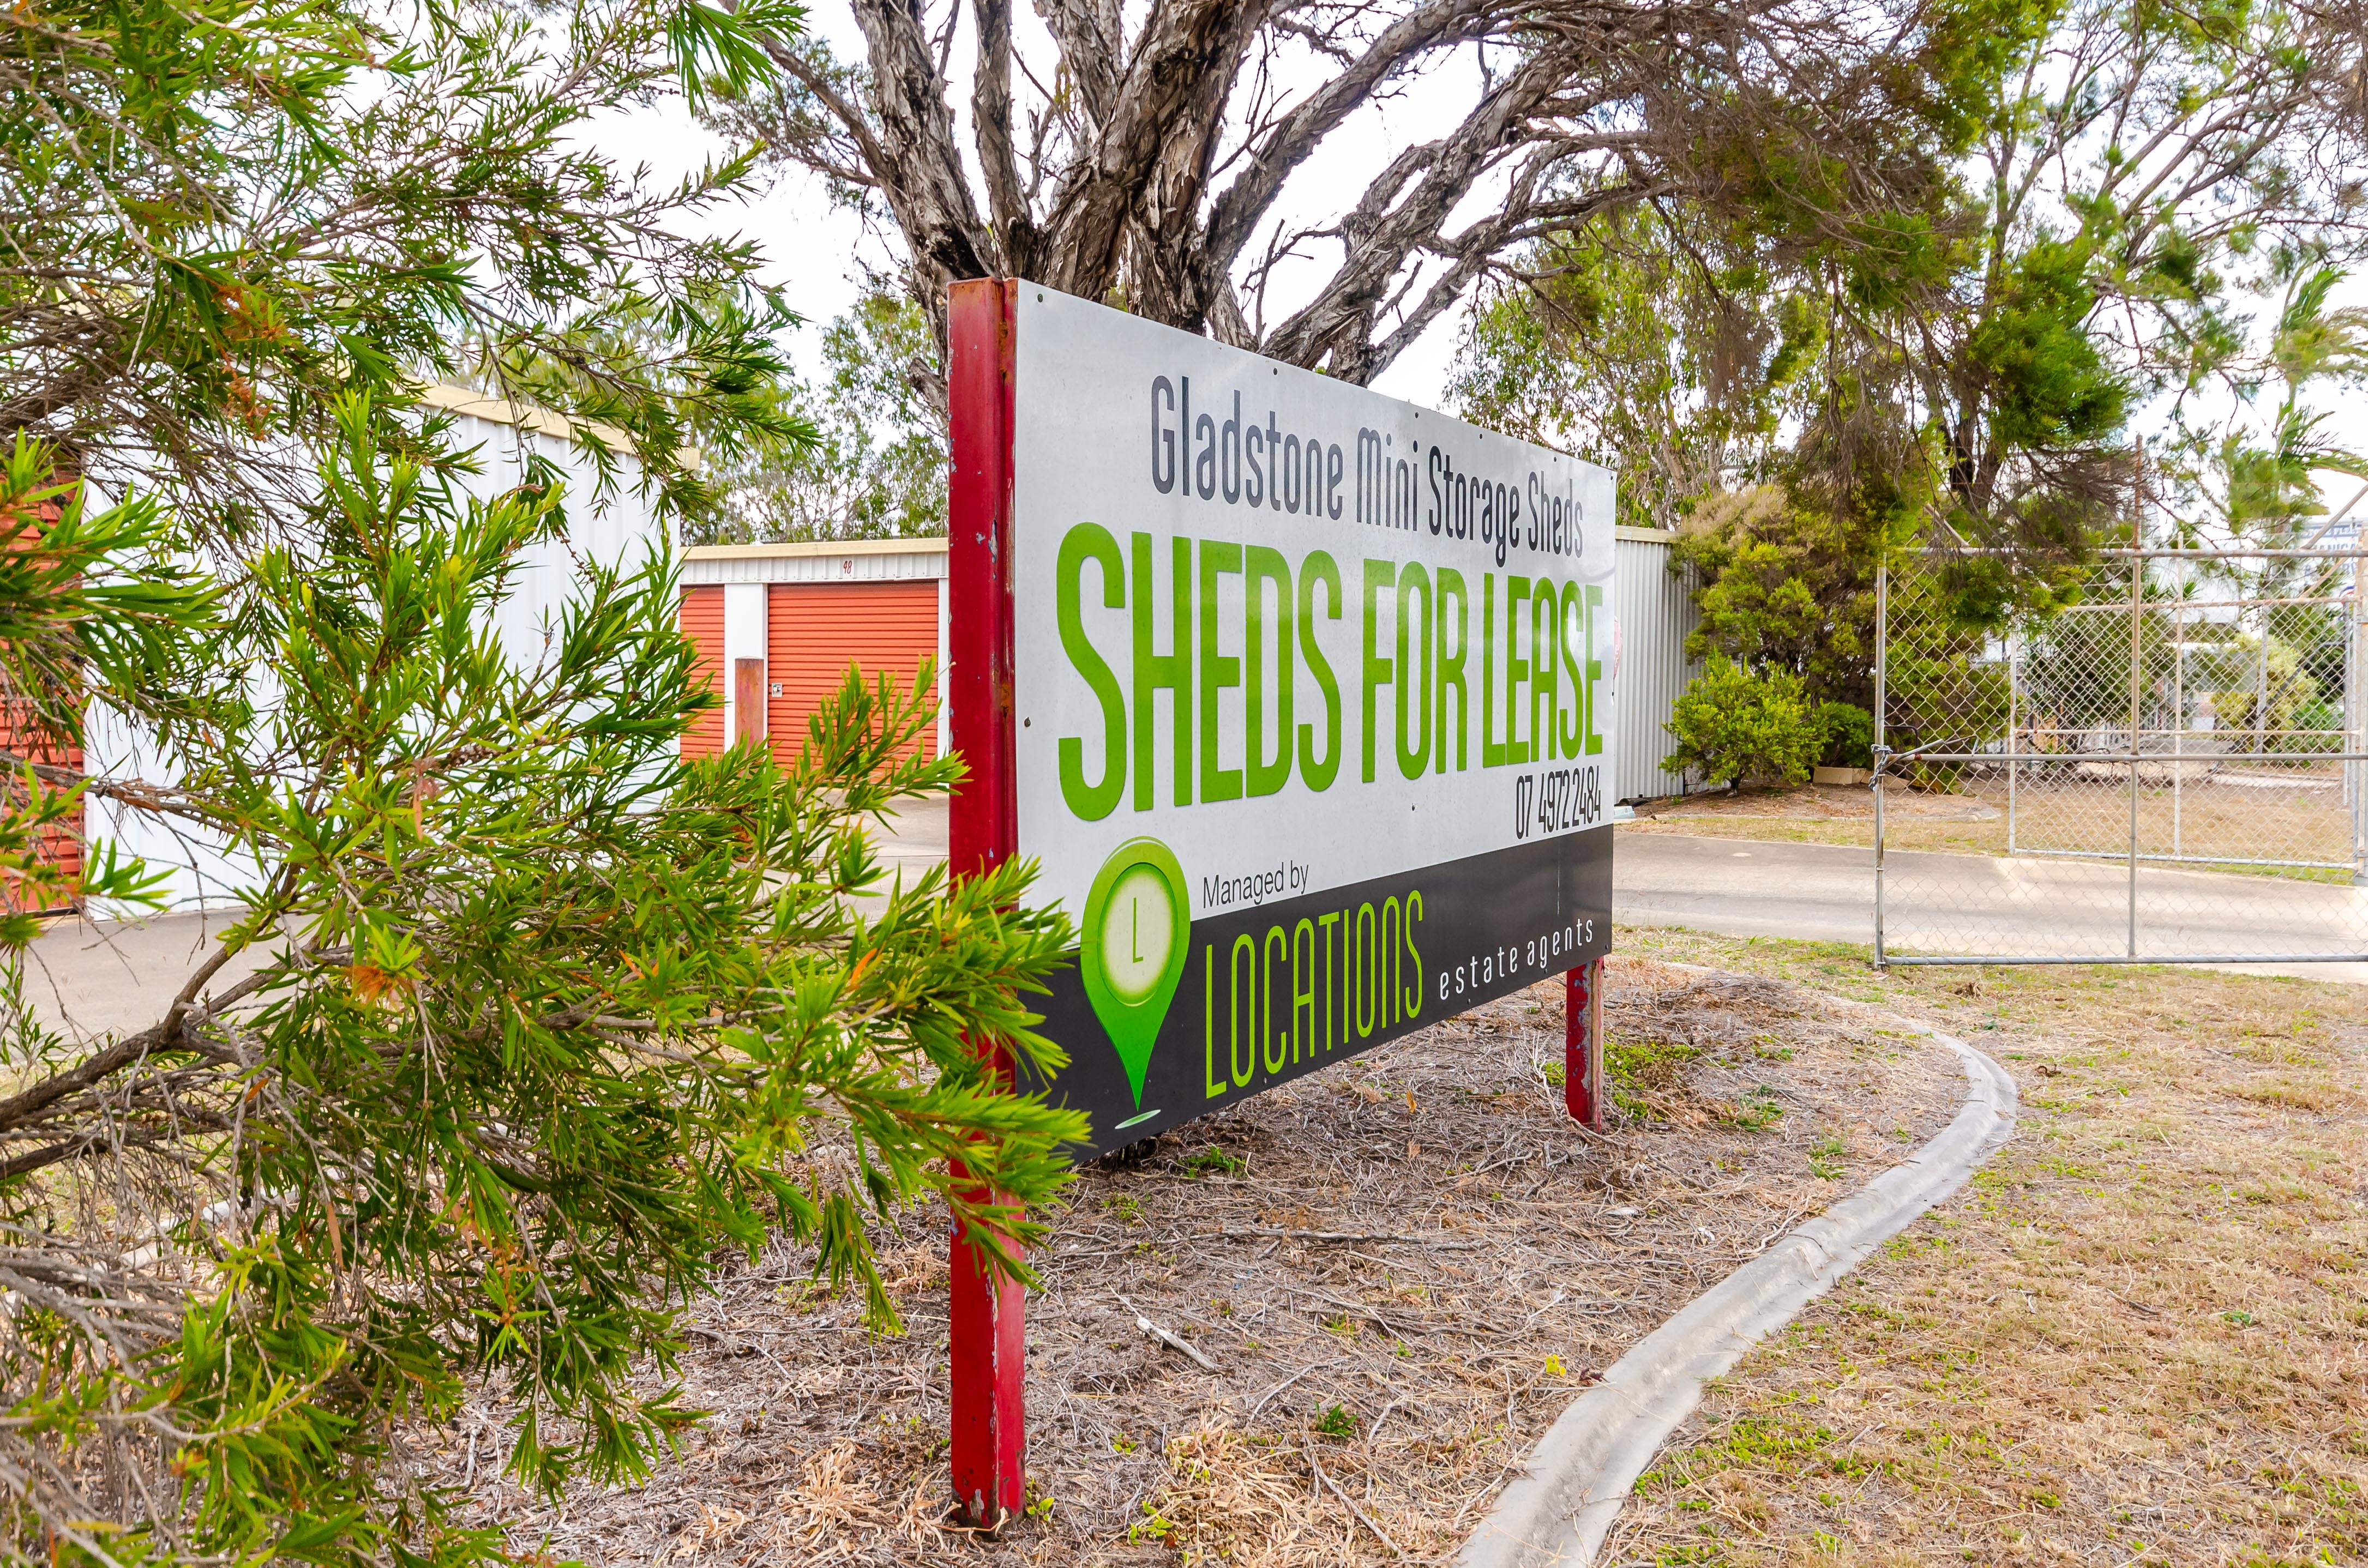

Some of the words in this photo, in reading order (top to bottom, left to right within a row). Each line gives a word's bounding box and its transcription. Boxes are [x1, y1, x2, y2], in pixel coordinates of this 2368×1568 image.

[1151, 375, 1343, 521] Gladstone
[1357, 426, 1418, 532] Mini
[1428, 445, 1520, 568] Storage
[1528, 471, 1583, 558] Sheds
[843, 560, 852, 574] 48
[1057, 523, 1341, 821] SHEDS
[1362, 559, 1467, 782] FOR
[1483, 573, 1602, 767] LEASE
[1516, 775, 1533, 840] 07
[1203, 861, 1284, 909] Managed
[1290, 860, 1309, 895] by
[1132, 897, 1144, 963] L
[1440, 946, 1518, 1000] estate
[1527, 918, 1592, 969] agents
[1205, 890, 1423, 1099] LOCATIONS
